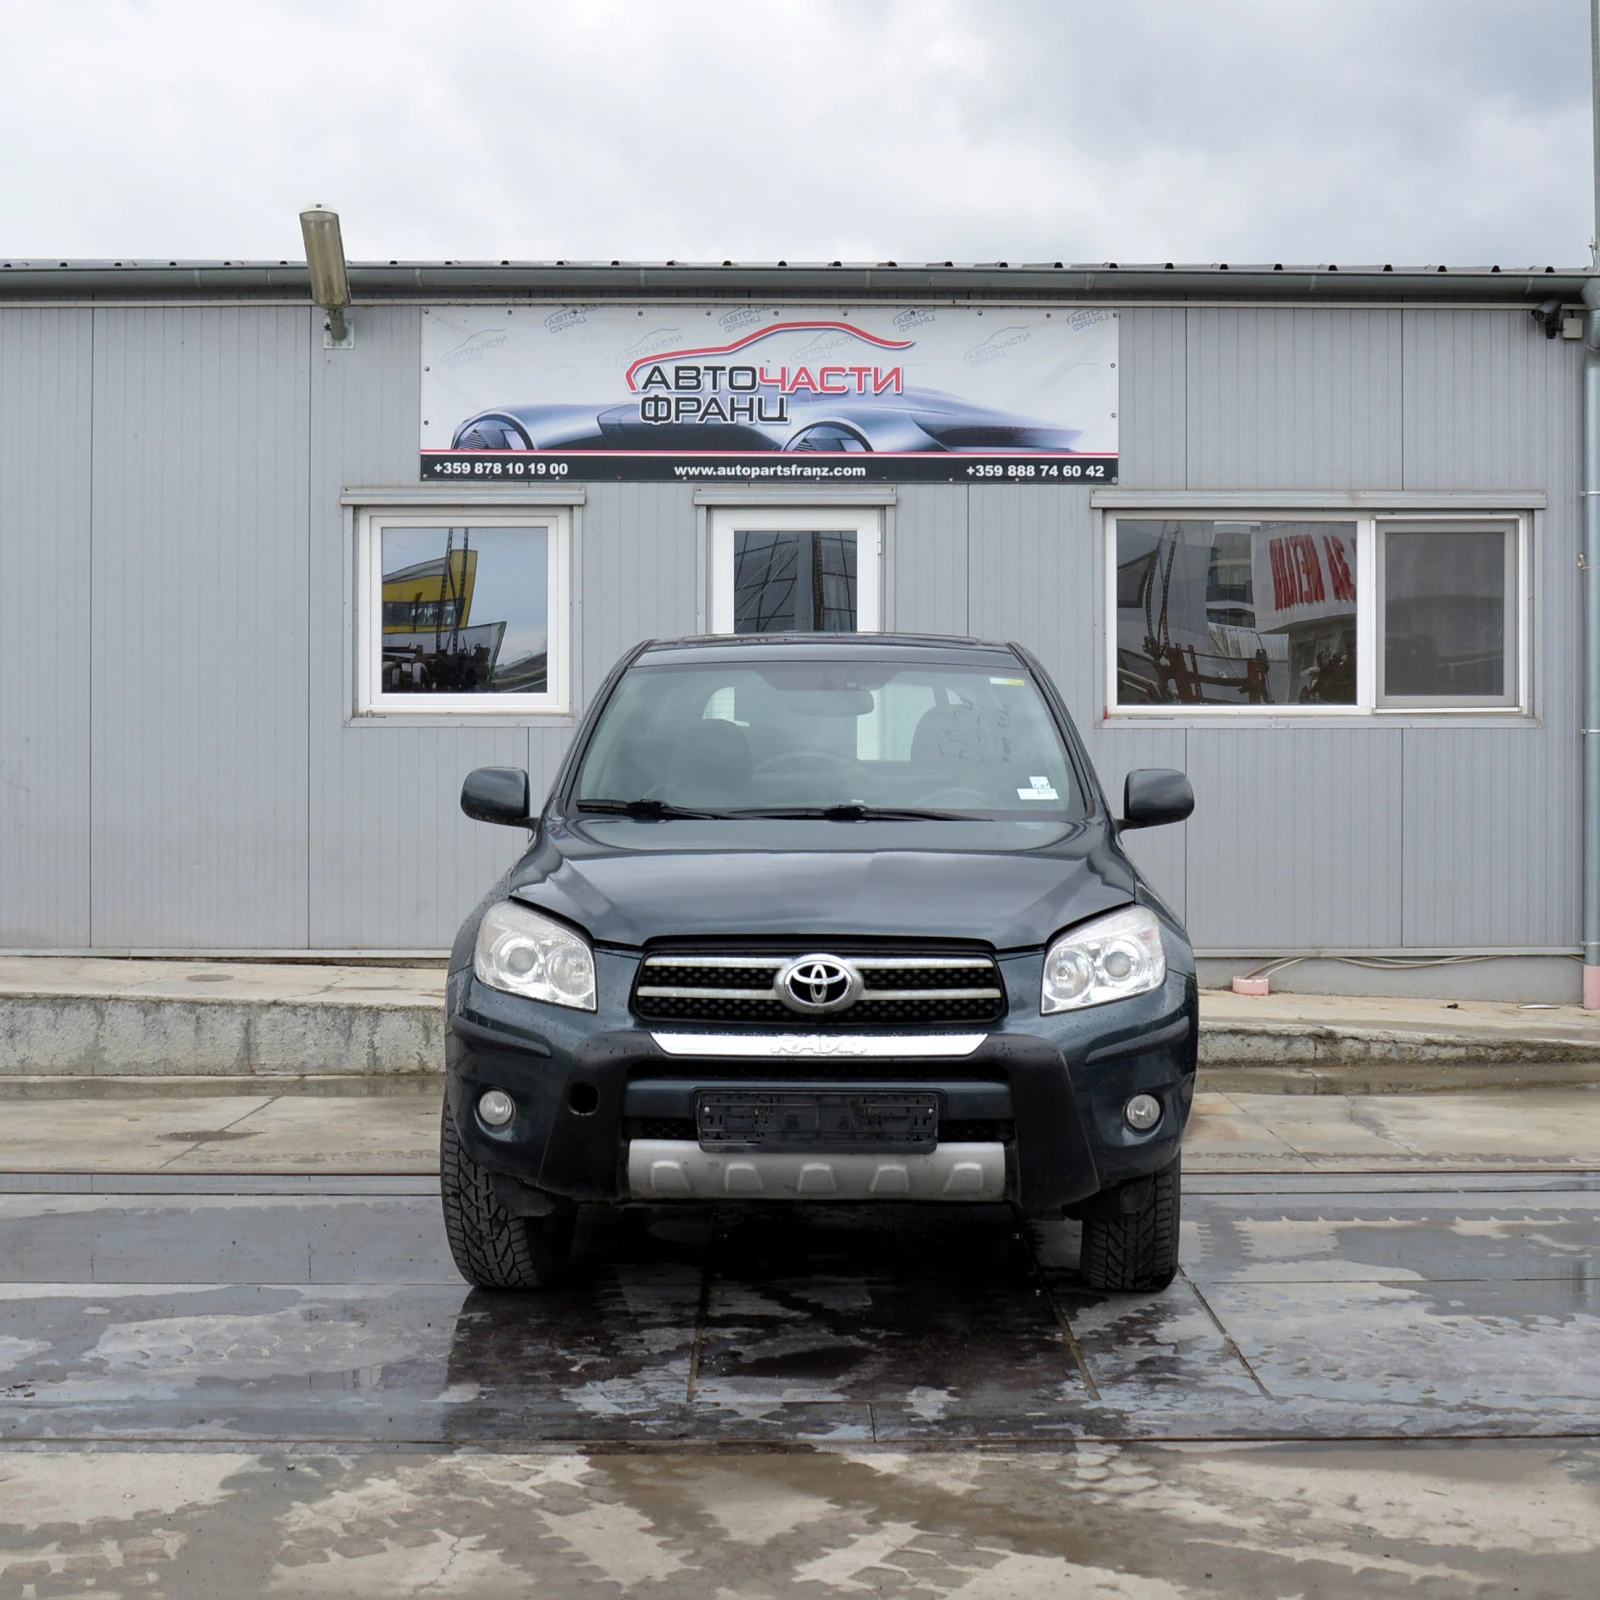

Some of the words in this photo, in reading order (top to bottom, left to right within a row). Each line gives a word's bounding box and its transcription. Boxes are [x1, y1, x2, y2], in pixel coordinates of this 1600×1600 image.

[550, 316, 587, 334] ФРАНЦ
[724, 316, 762, 333] ФРАНЦ
[899, 315, 936, 332] ФРАНЦ
[1073, 313, 1109, 331] ФРАНЦ
[445, 334, 509, 362] АВТОЧАСТИ
[968, 333, 1032, 360] АВТОЧАСТИ
[641, 365, 902, 393] АВТОЧАСТИ
[641, 394, 789, 425] ФРАНЦ
[434, 462, 471, 475] +359
[473, 462, 503, 475] 878
[505, 462, 525, 475] 10
[527, 462, 547, 475] 19
[549, 462, 569, 475] 00
[673, 464, 867, 479] www.autopartsfranz.com
[966, 464, 1004, 477] +359
[1007, 464, 1036, 477] 888
[1039, 464, 1059, 477] 74
[1062, 464, 1082, 477] 60
[1085, 464, 1105, 477] 42
